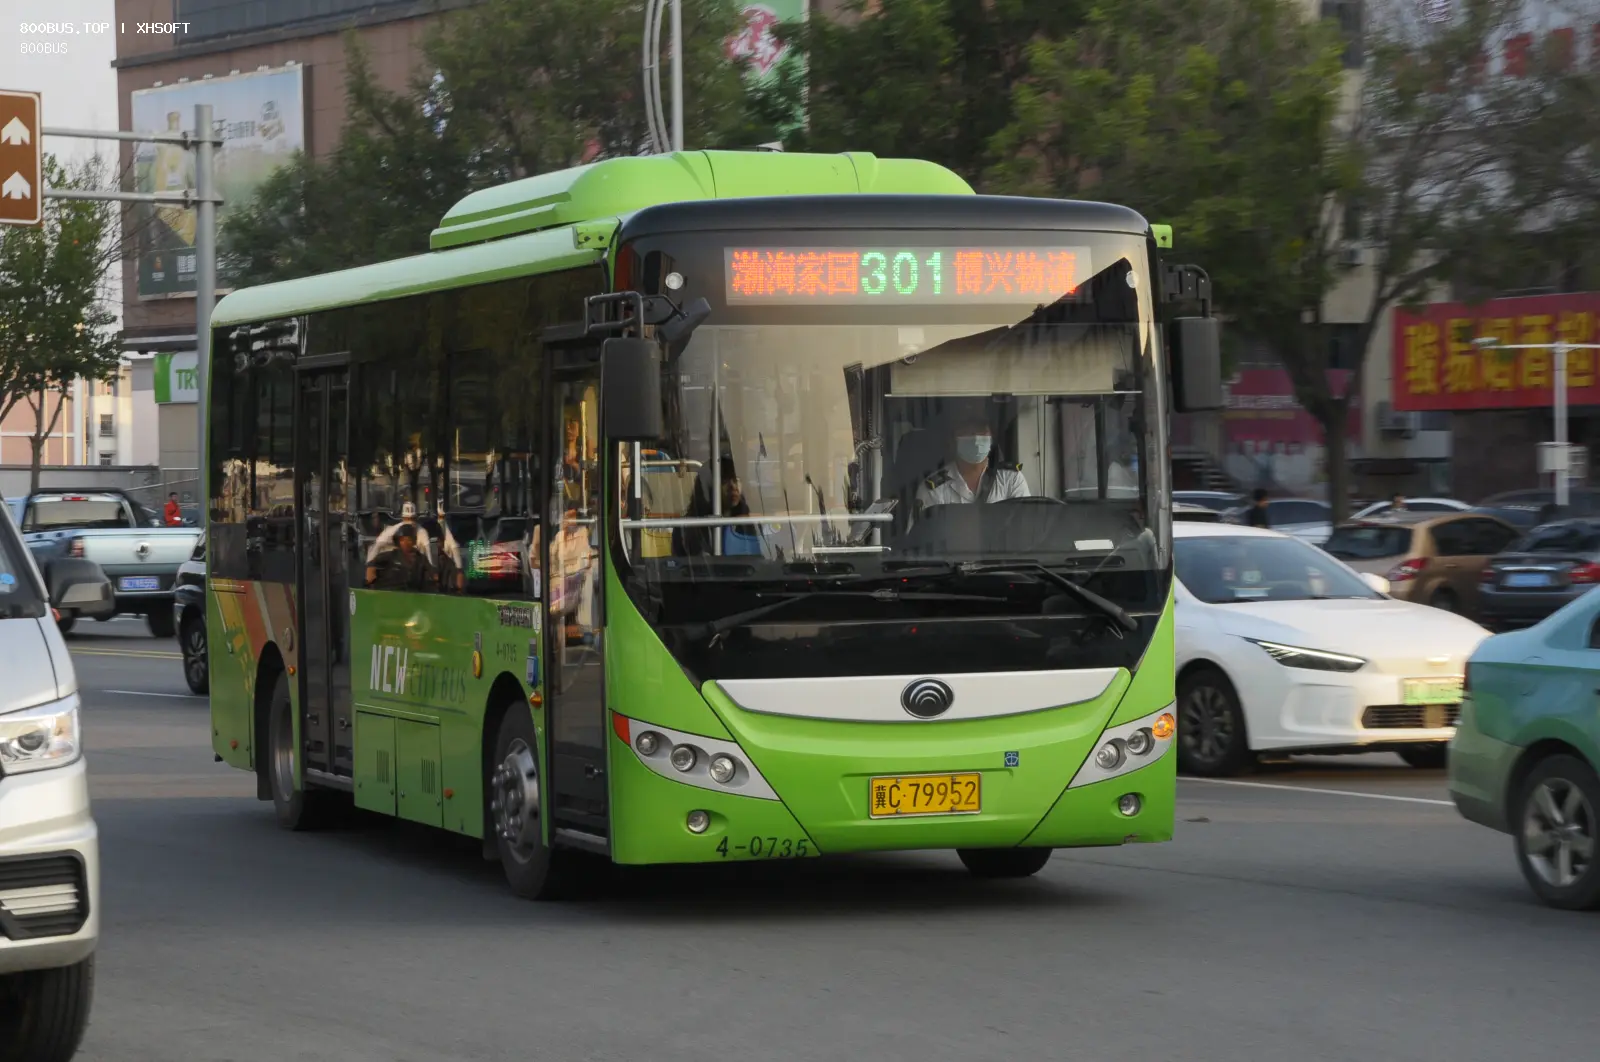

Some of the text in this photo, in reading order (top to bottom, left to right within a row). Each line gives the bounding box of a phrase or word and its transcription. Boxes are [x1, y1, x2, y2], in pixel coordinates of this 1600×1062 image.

[731, 250, 1077, 295] 渤海家园 301 博兴物流
[175, 368, 200, 390] TR
[440, 666, 468, 705] BUS
[716, 835, 810, 858] 4-0735
